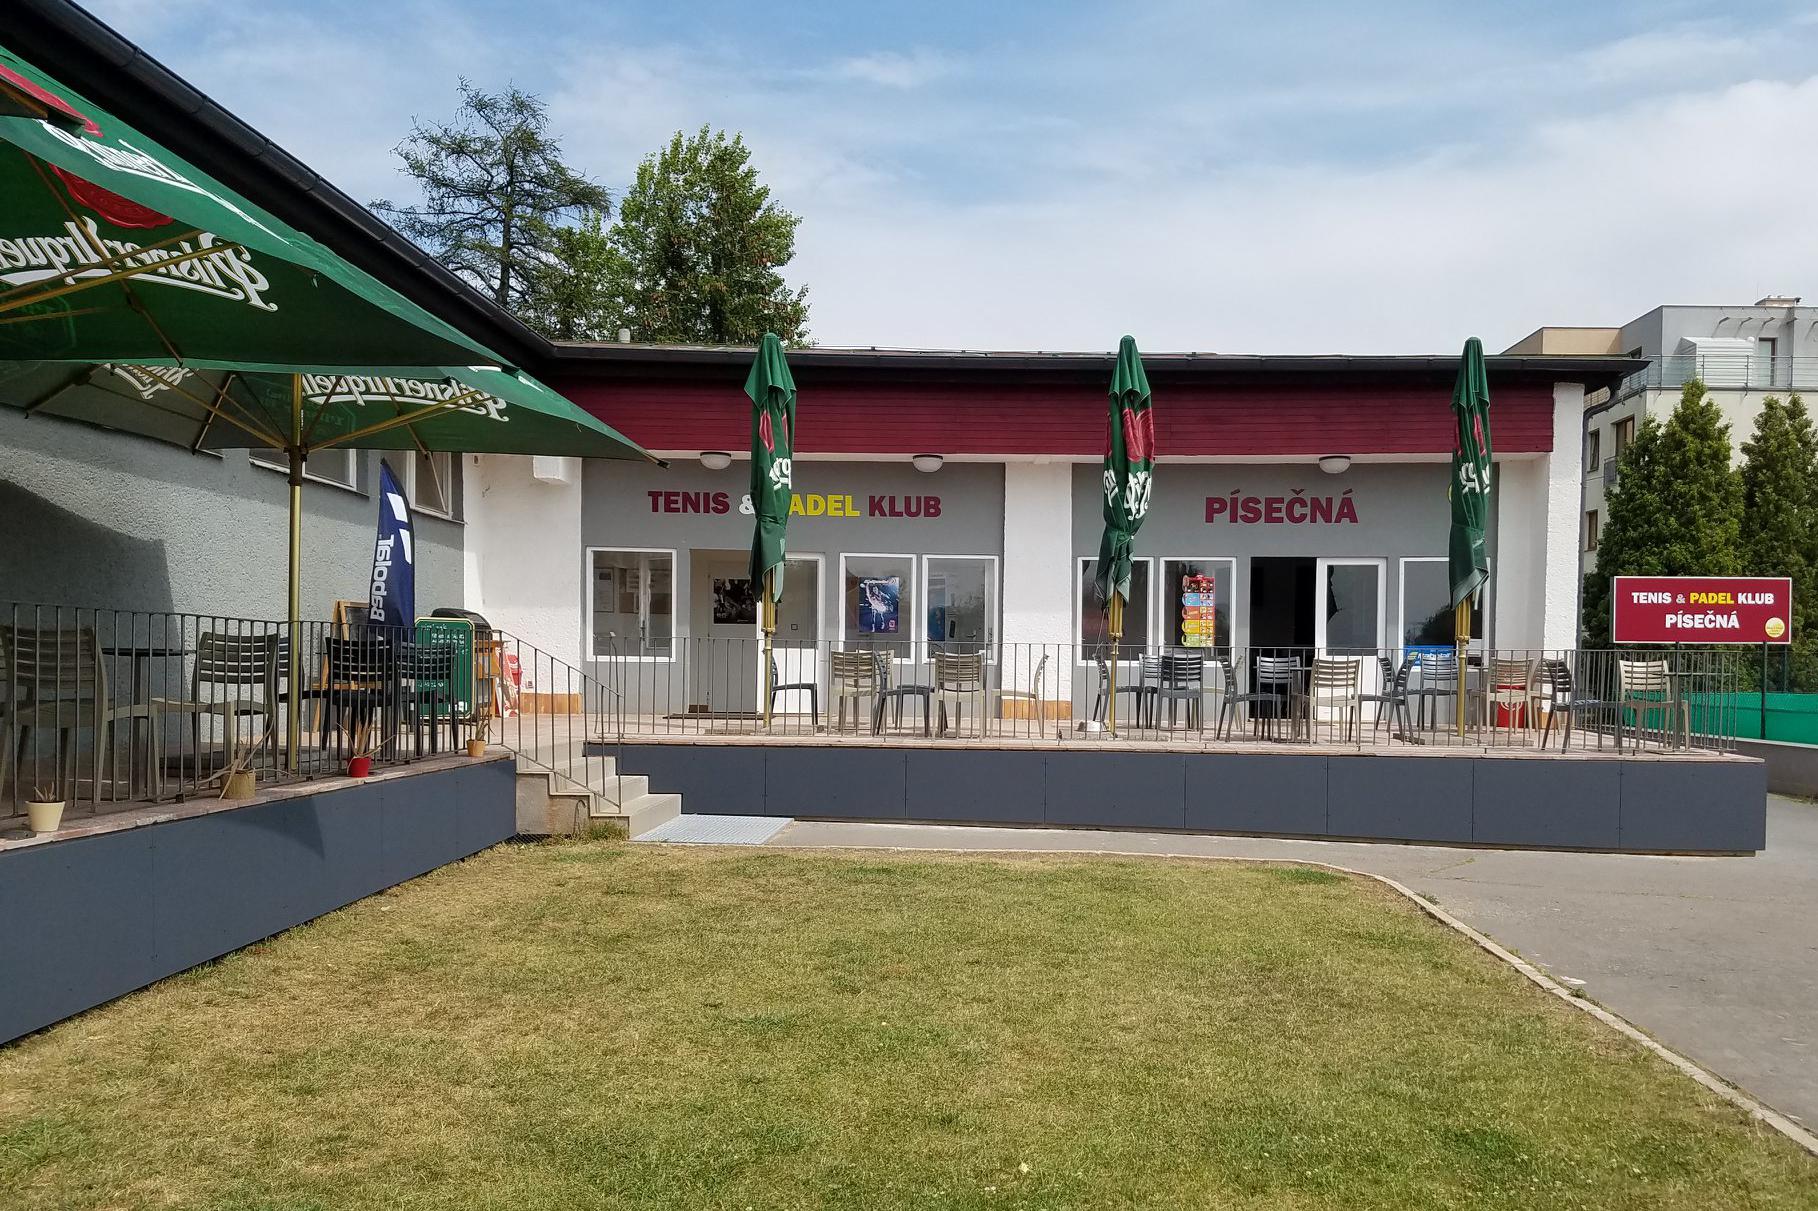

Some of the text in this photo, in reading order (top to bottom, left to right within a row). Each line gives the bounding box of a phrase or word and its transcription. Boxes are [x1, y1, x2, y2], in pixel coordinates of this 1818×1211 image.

[647, 490, 942, 517] TENIS & ADEL KLUB
[1205, 488, 1358, 524] PÍSEČNÁ
[1632, 592, 1774, 604] TENIS & PADEL KLUB
[1665, 610, 1740, 628] PÍSEČNÁ
